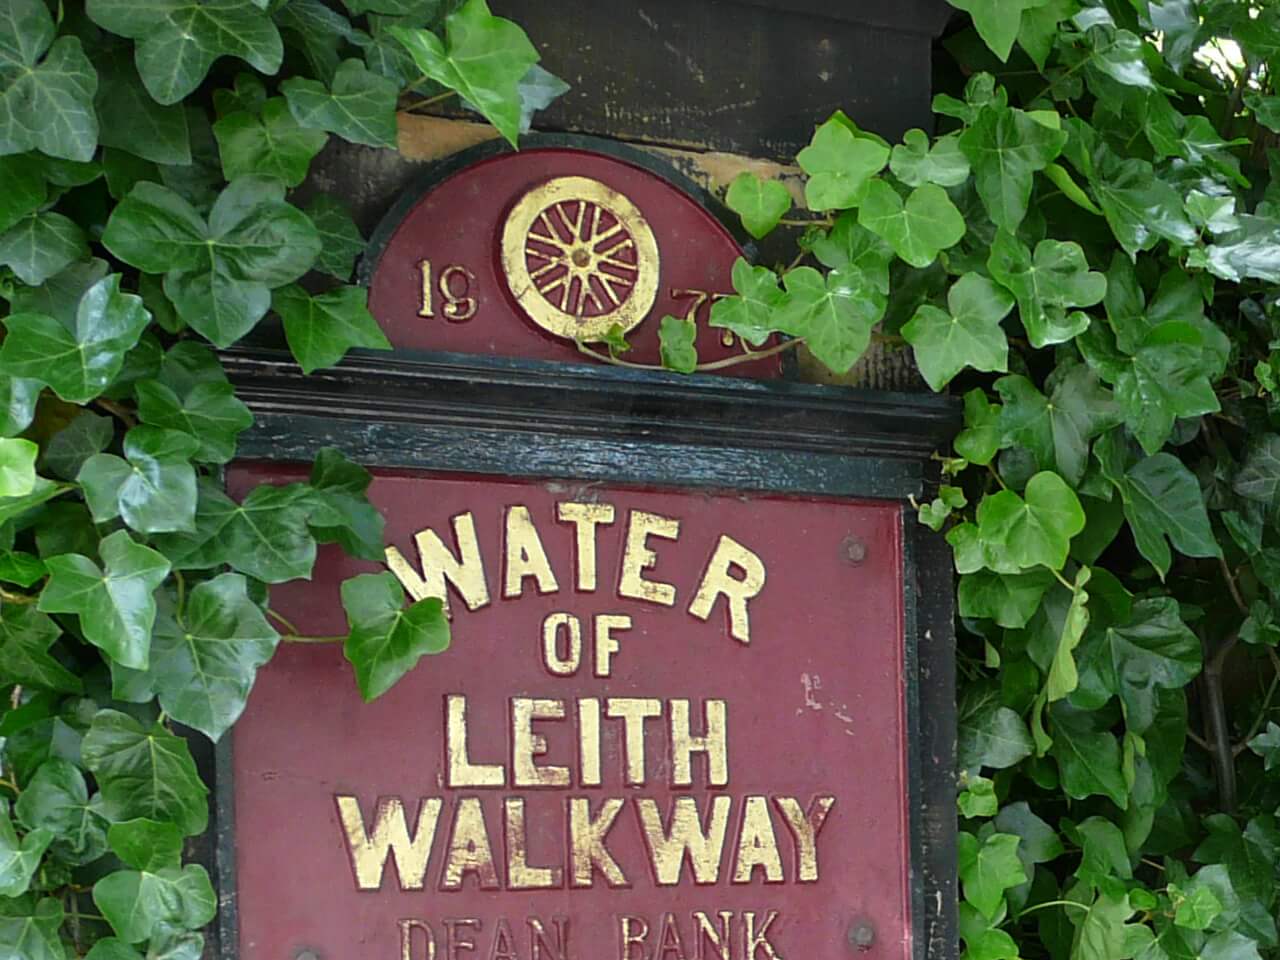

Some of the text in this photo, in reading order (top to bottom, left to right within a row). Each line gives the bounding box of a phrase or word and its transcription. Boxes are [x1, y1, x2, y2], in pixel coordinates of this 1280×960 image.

[416, 260, 478, 320] 19
[384, 502, 766, 642] WATER
[543, 612, 632, 676] OF
[445, 695, 729, 786] LEITH
[335, 796, 836, 889] WALKWAY
